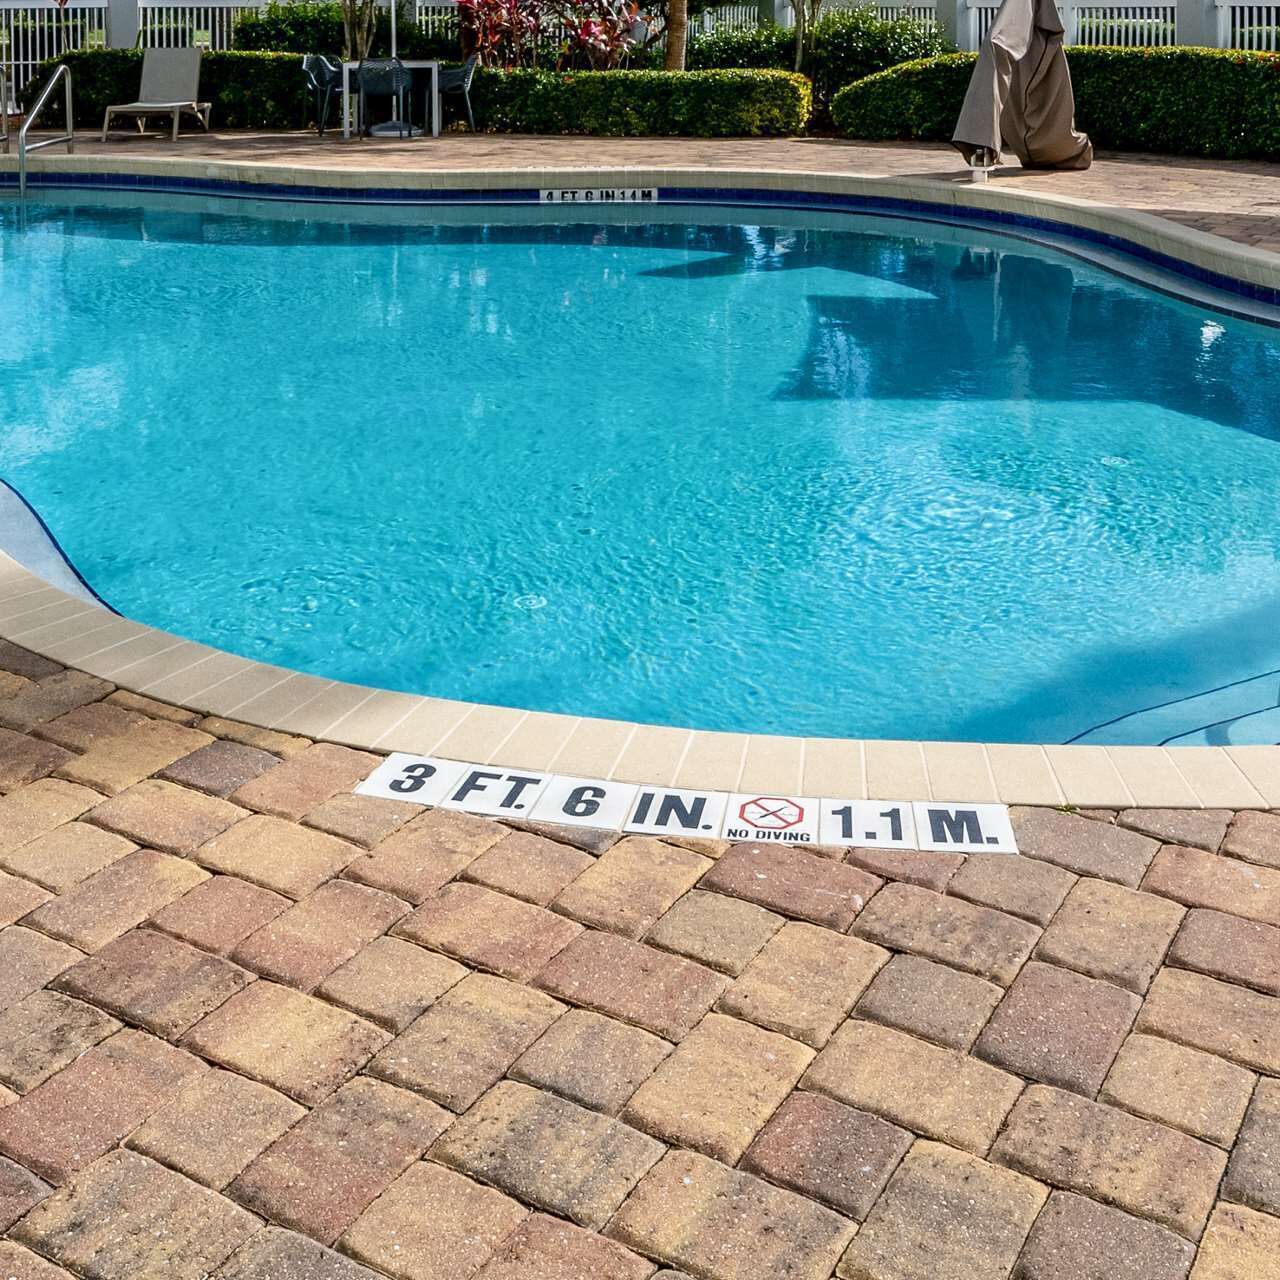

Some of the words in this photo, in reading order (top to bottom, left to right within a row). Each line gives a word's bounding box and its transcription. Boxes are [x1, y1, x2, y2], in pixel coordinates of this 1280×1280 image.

[600, 190, 615, 201] IN
[641, 190, 653, 201] M
[388, 762, 438, 794] 3
[451, 770, 543, 810] FT.
[561, 785, 607, 818] 6
[631, 792, 714, 830] IN.
[831, 805, 904, 841] 1.1
[926, 808, 1000, 845] M.
[726, 828, 750, 839] NO
[755, 829, 811, 843] DIVING
